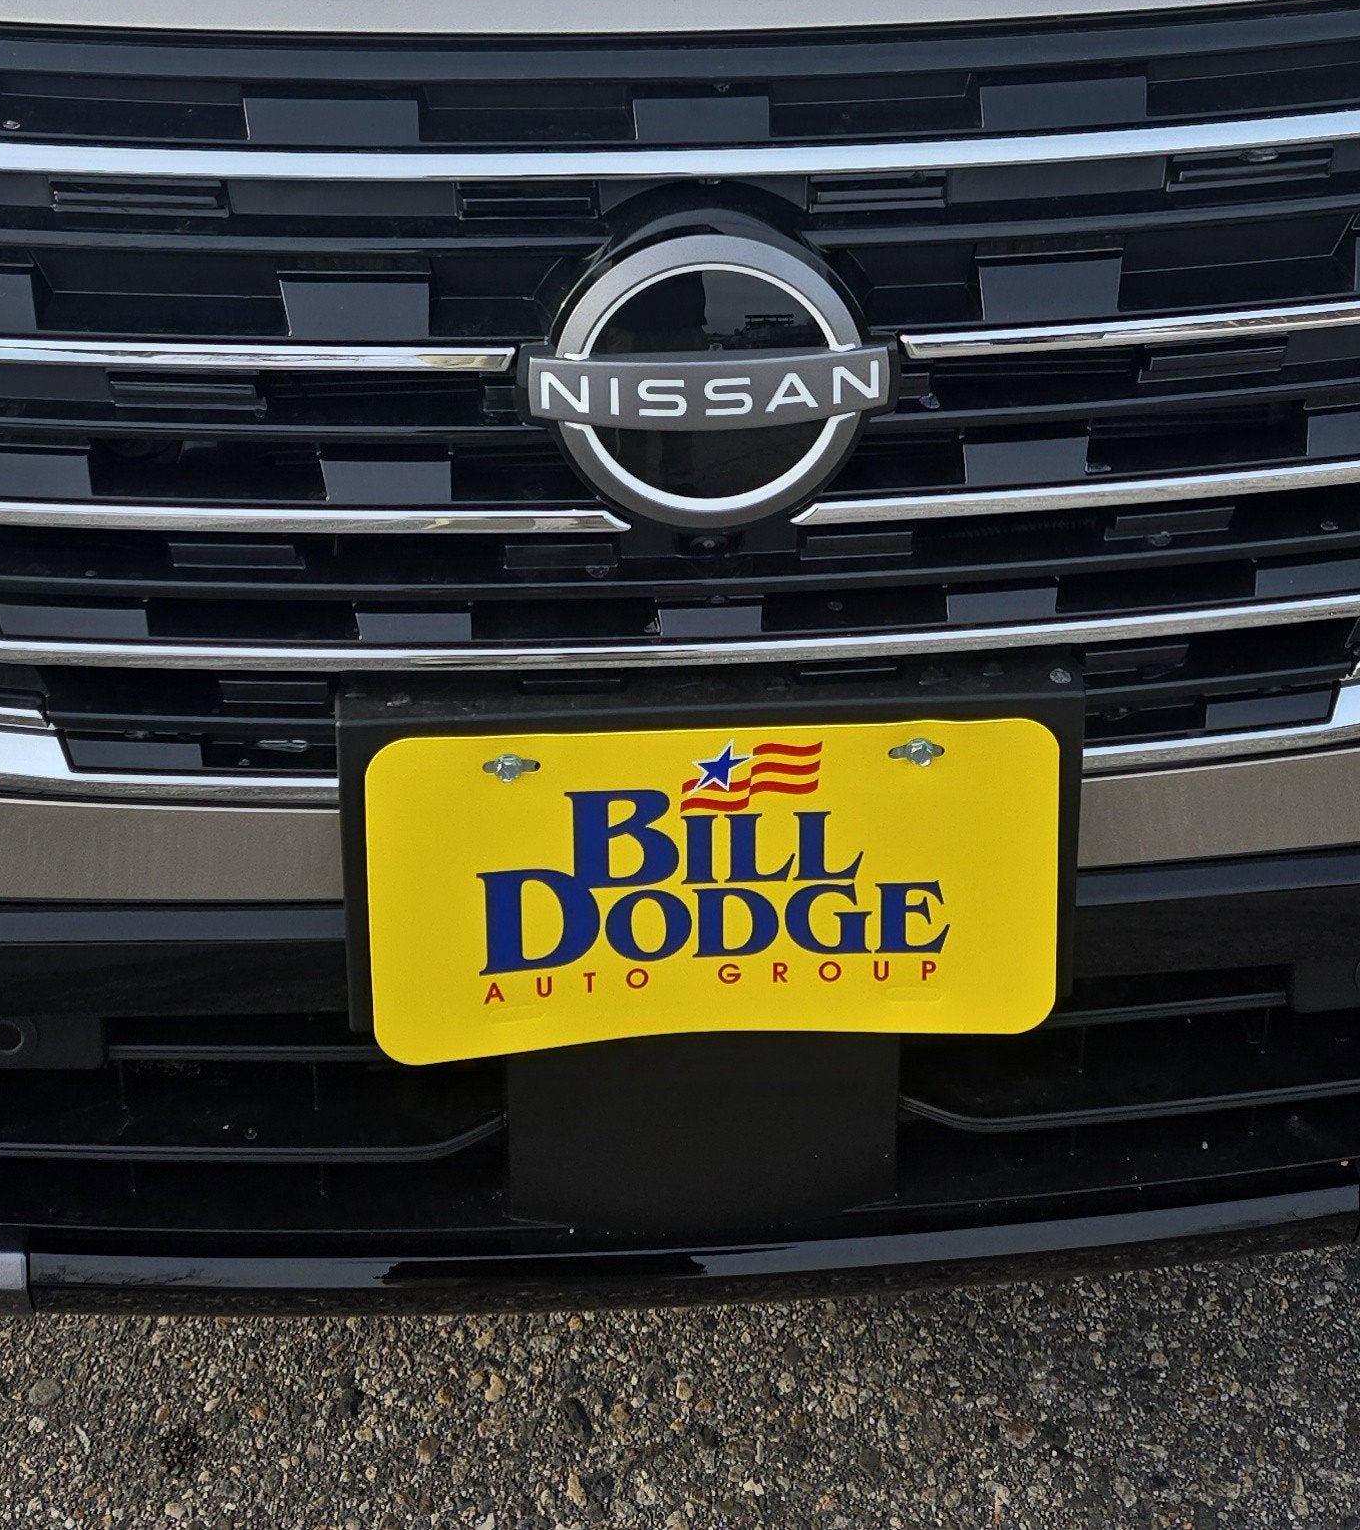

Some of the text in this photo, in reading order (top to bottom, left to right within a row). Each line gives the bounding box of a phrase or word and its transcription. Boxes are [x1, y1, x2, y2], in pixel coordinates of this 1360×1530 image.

[540, 360, 880, 417] NISSAN
[563, 789, 864, 888] BILL
[476, 869, 951, 976] DODGE
[484, 960, 938, 1005] AUTO GROUP
